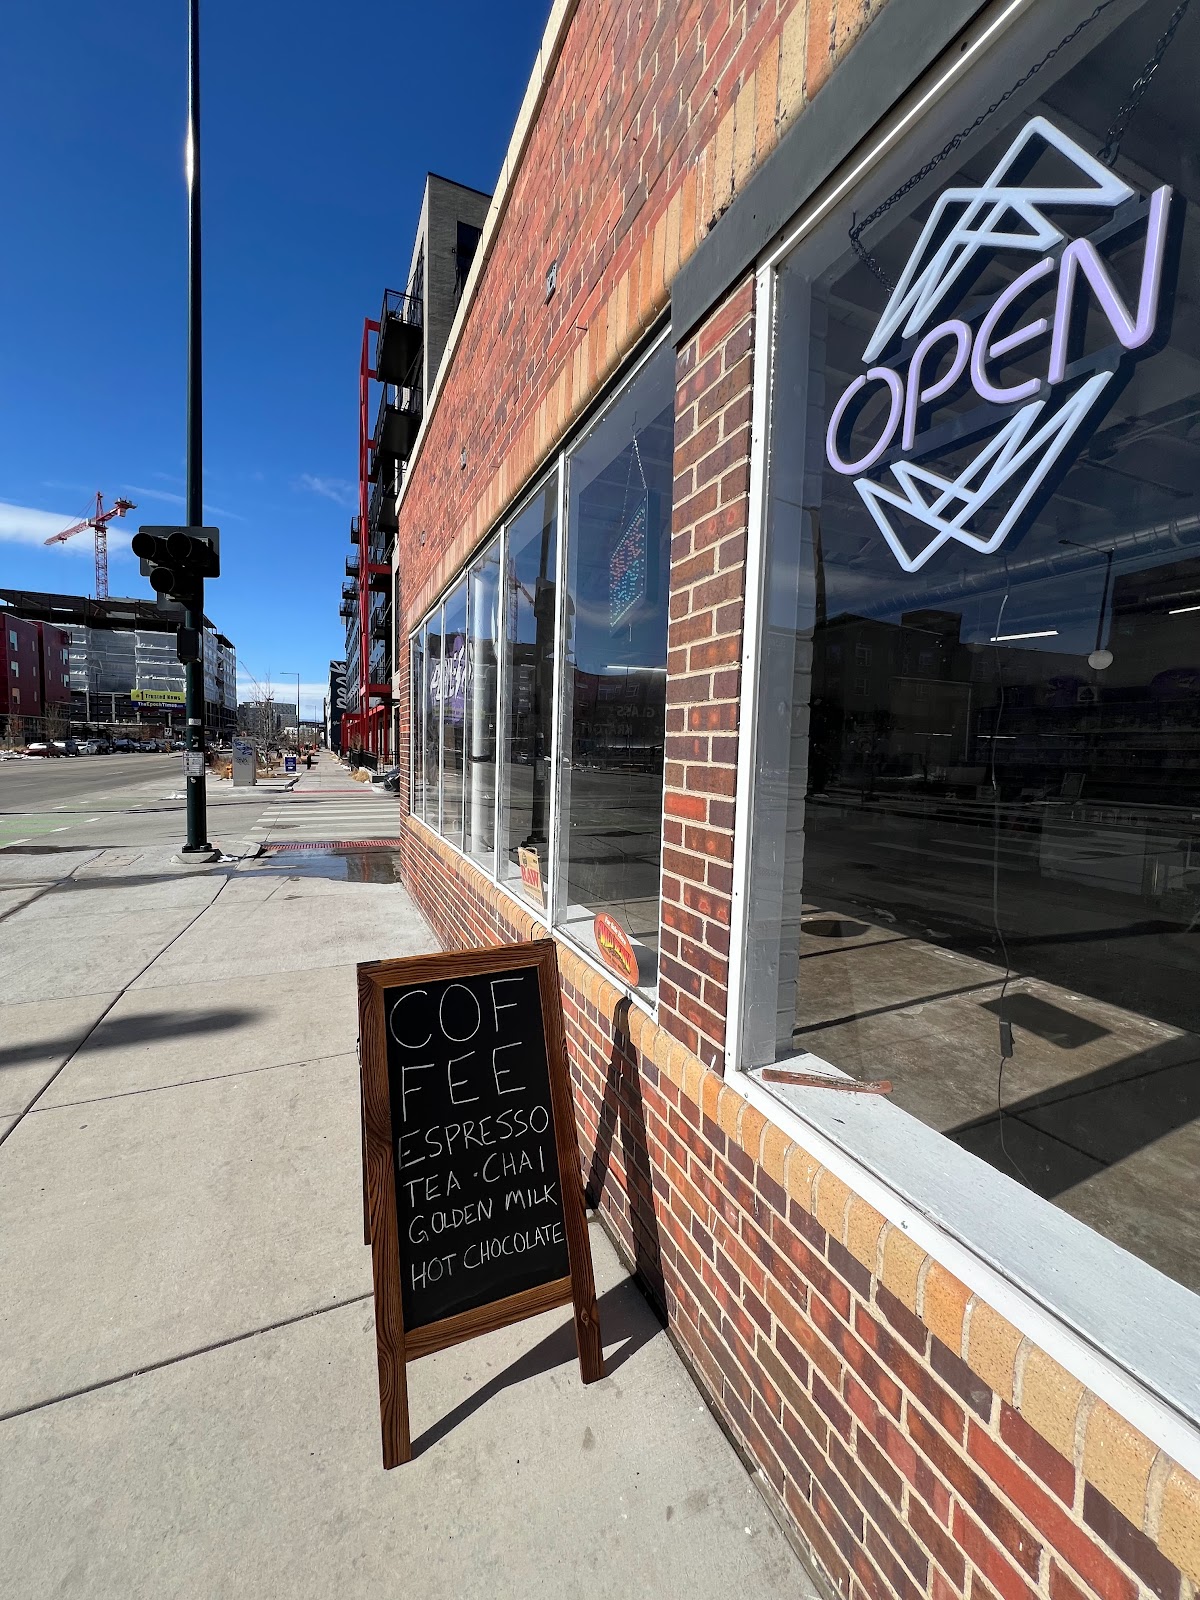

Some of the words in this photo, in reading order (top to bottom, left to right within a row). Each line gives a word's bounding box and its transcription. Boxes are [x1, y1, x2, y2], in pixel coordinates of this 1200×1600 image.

[826, 184, 1173, 475] OPEN
[520, 864, 539, 888] RAW
[389, 977, 524, 1049] COF
[401, 1041, 526, 1122] FEE
[398, 1105, 549, 1171] ESPRESSO
[403, 1171, 461, 1208] TEA
[408, 1198, 493, 1244] GOLDEN
[505, 1182, 558, 1212] MILK
[411, 1253, 457, 1291] HOT
[463, 1221, 566, 1270] CHOCOLATE
